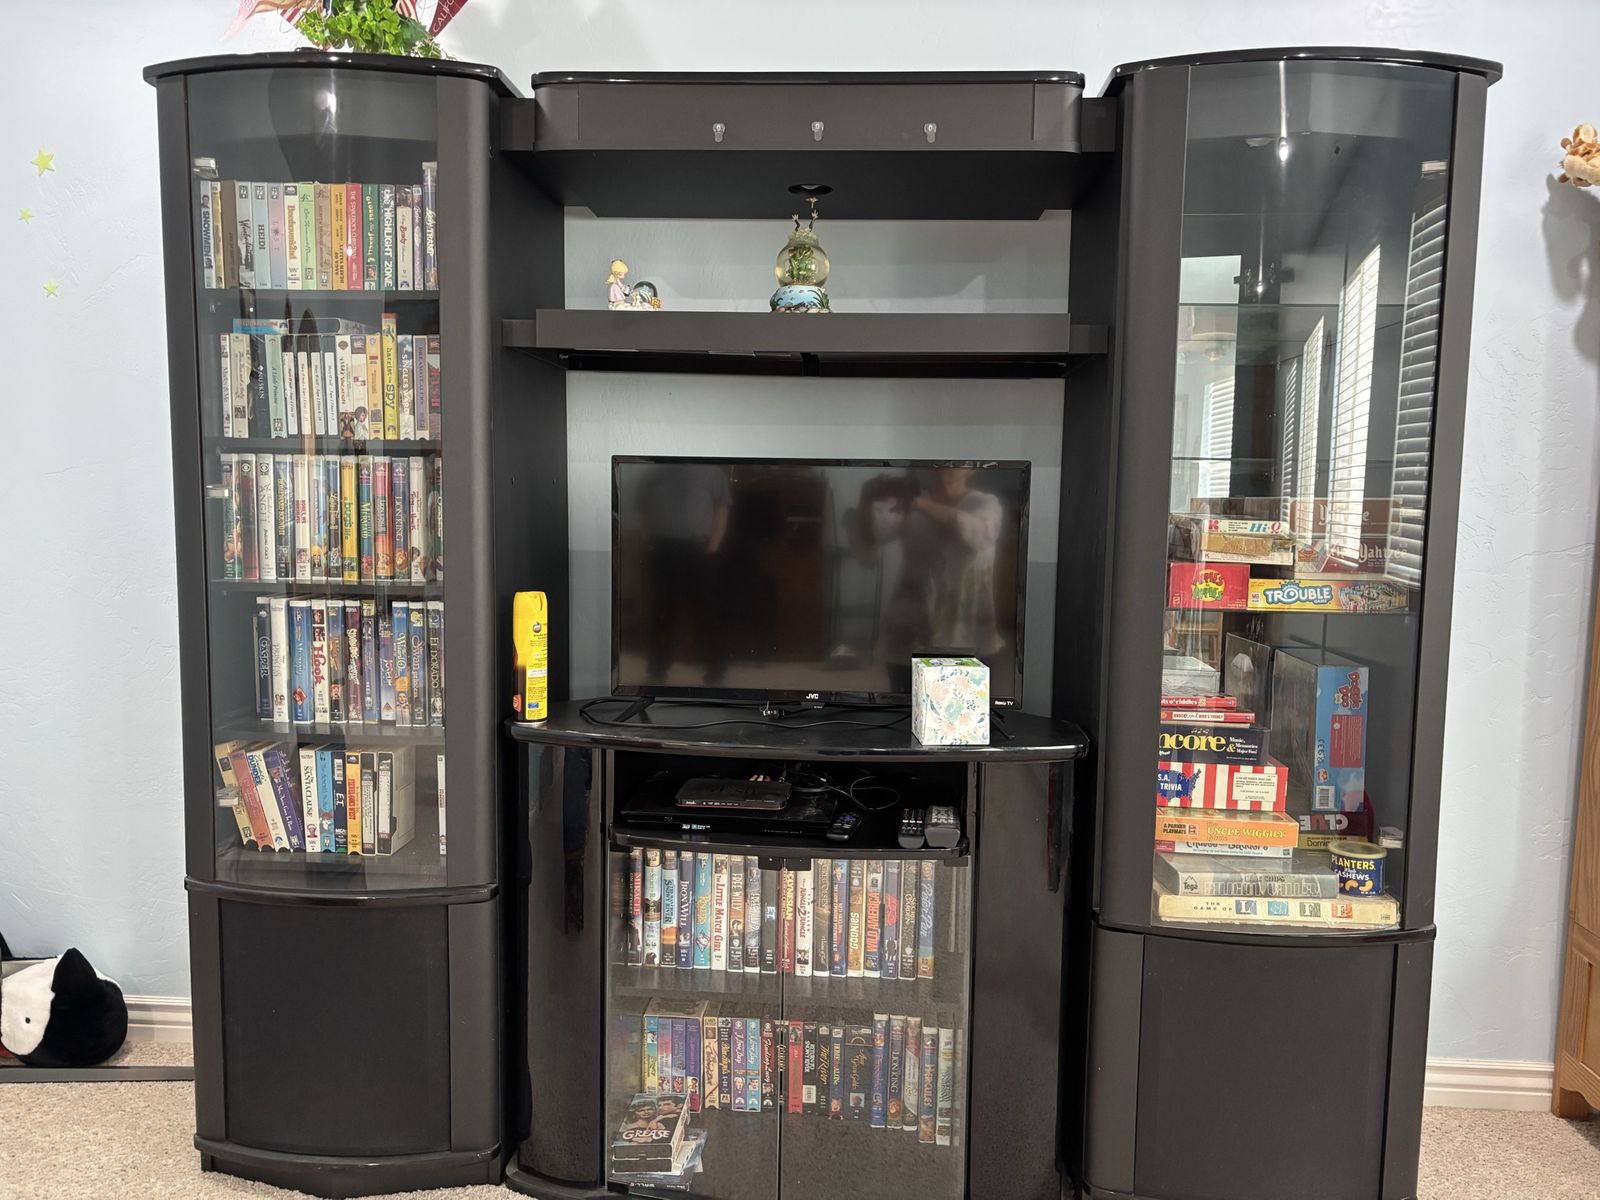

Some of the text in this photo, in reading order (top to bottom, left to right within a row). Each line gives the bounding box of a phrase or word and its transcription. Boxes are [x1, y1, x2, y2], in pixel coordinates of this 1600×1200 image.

[384, 208, 392, 287] HIGHLIGHT ZONE
[383, 384, 395, 410] spy
[344, 502, 353, 528] bug's
[361, 502, 371, 539] MERMAID
[1266, 588, 1331, 602] TROUBLE
[259, 637, 270, 678] CASPER
[397, 633, 406, 659] Wizard
[412, 635, 425, 670] Swan
[314, 644, 326, 687] Hook
[430, 637, 439, 688] EL DORADO
[1227, 742, 1237, 752] &
[248, 754, 262, 786] DUNDEE
[1160, 783, 1182, 792] TRIVIA
[1208, 826, 1240, 836] UNCLE
[1299, 815, 1348, 831] CLUE
[1332, 855, 1374, 870] PLANTERS
[1334, 869, 1370, 881] CASHEWS
[716, 883, 725, 906] LITTLE
[731, 873, 743, 911] FREE WILLY
[1183, 882, 1198, 891] Tega
[680, 880, 689, 928] IRON WILL
[798, 908, 806, 916] 2
[920, 883, 933, 936] Peter Pan
[714, 908, 724, 933] MATCH
[850, 912, 860, 949] GOONIES
[867, 892, 880, 952] WILD AMERICA
[714, 935, 723, 952] GIRL
[735, 1050, 745, 1063] Lucy
[736, 1039, 744, 1051] Love
[749, 1051, 758, 1064] Lucy
[750, 1038, 758, 1052] Love
[763, 1038, 772, 1082] Finding Lucy
[818, 1044, 830, 1085] The River
[891, 1052, 900, 1092] LION KING
[924, 1064, 935, 1107] HERCULES
[622, 1130, 670, 1140] GREASE
